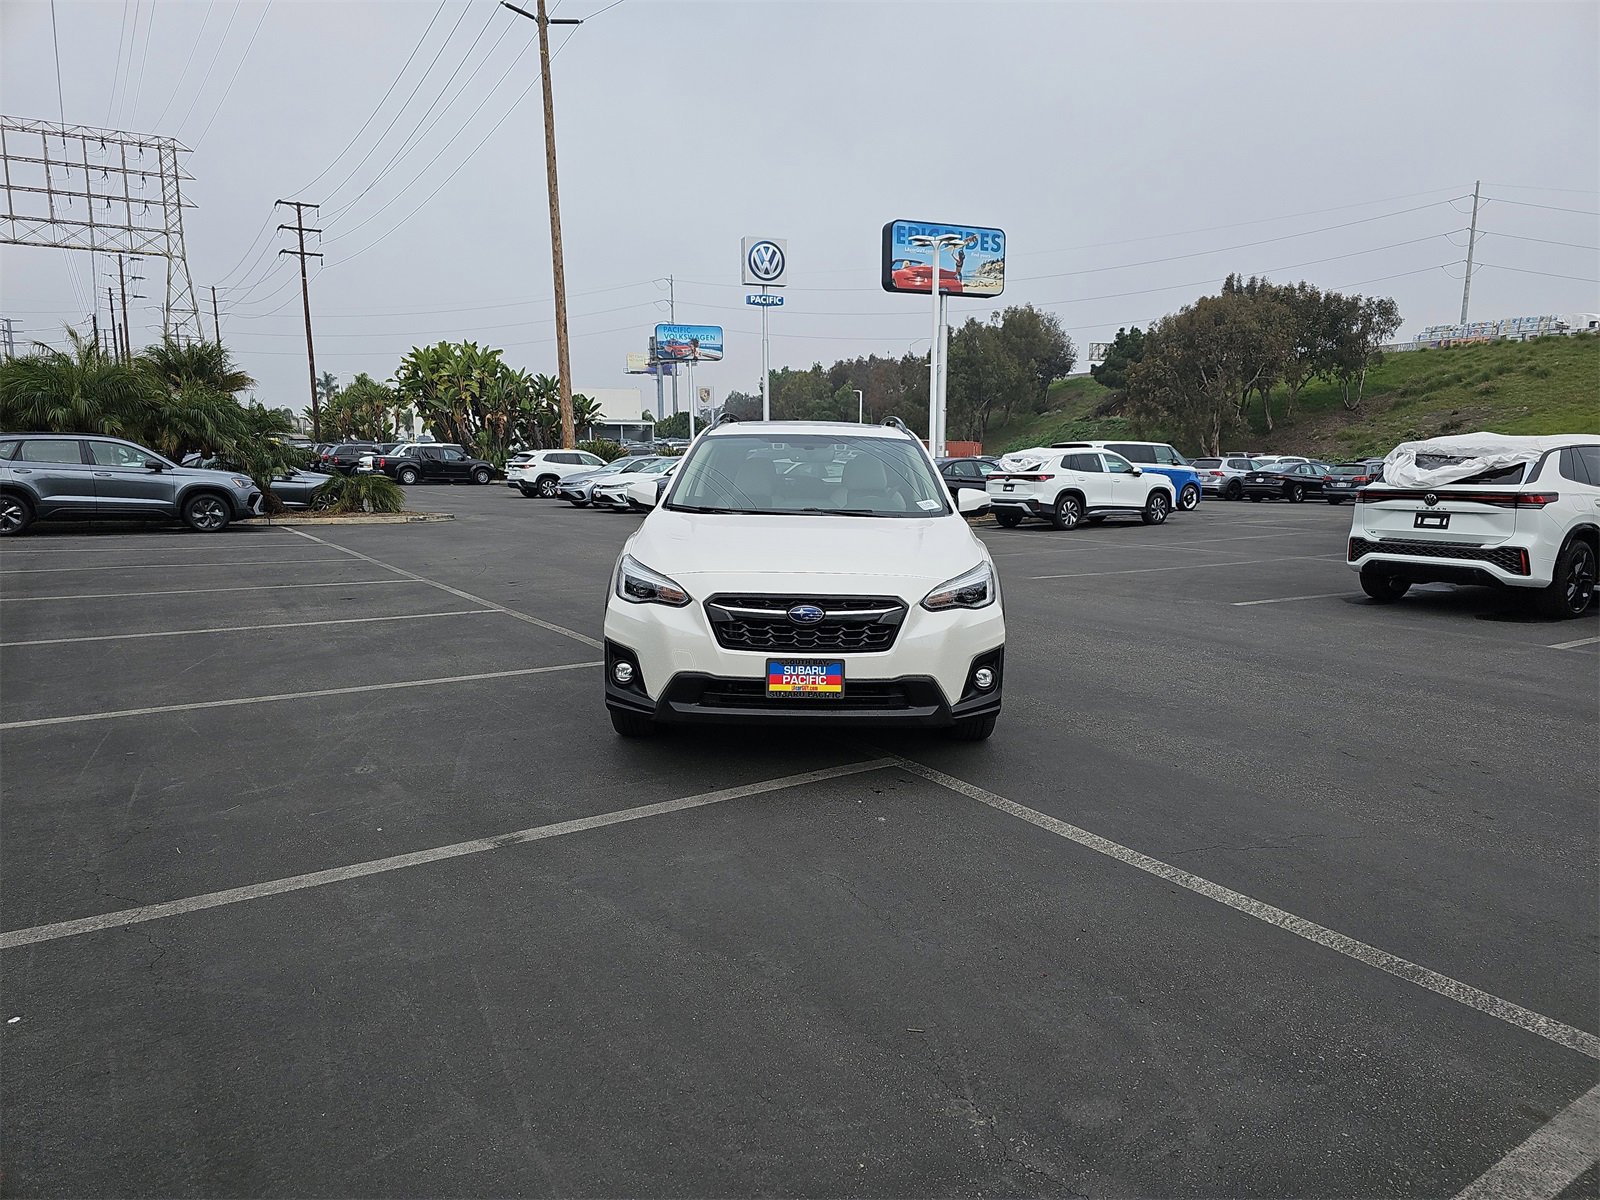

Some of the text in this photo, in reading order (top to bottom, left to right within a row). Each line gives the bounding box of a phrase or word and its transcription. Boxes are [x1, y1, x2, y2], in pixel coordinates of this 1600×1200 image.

[750, 295, 782, 304] PACIFIC
[784, 666, 826, 675] SUBARU
[783, 675, 827, 684] PACIFIC
